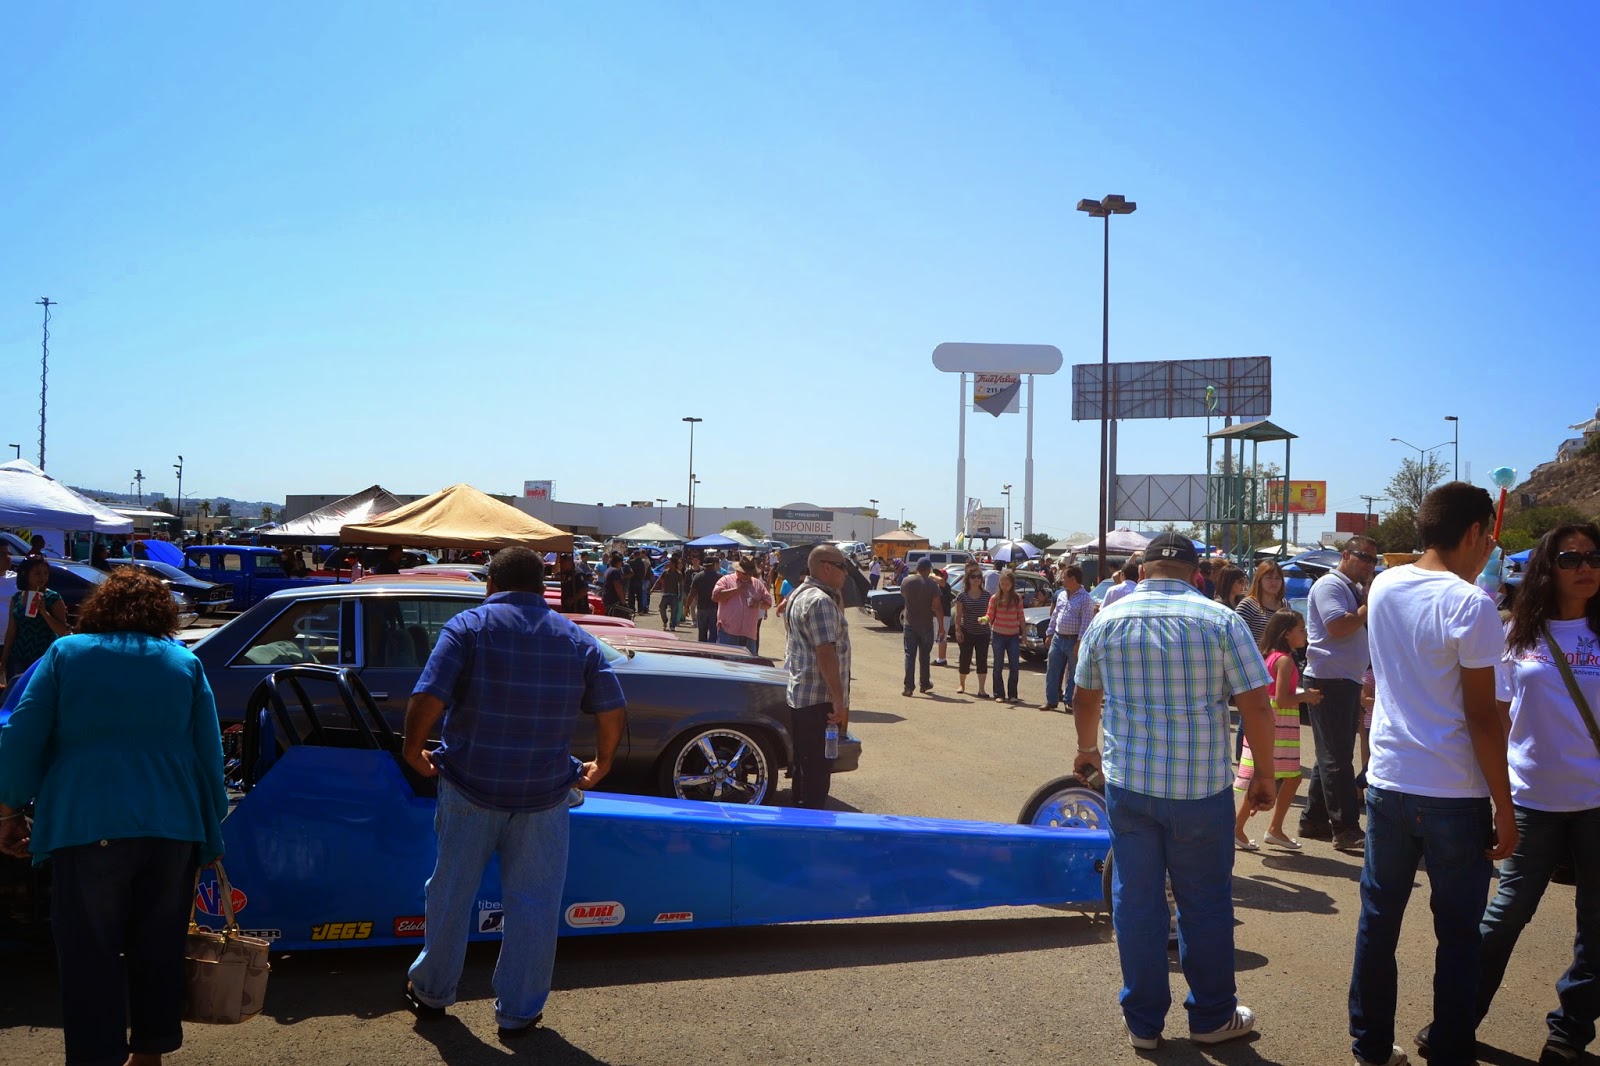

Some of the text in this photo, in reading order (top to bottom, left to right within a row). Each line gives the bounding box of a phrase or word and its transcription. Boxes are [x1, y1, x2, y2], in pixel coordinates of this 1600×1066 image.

[774, 520, 832, 533] DISPONIBLE
[573, 905, 616, 918] DART
[658, 912, 692, 920] ARP
[311, 921, 373, 940] JEG'S
